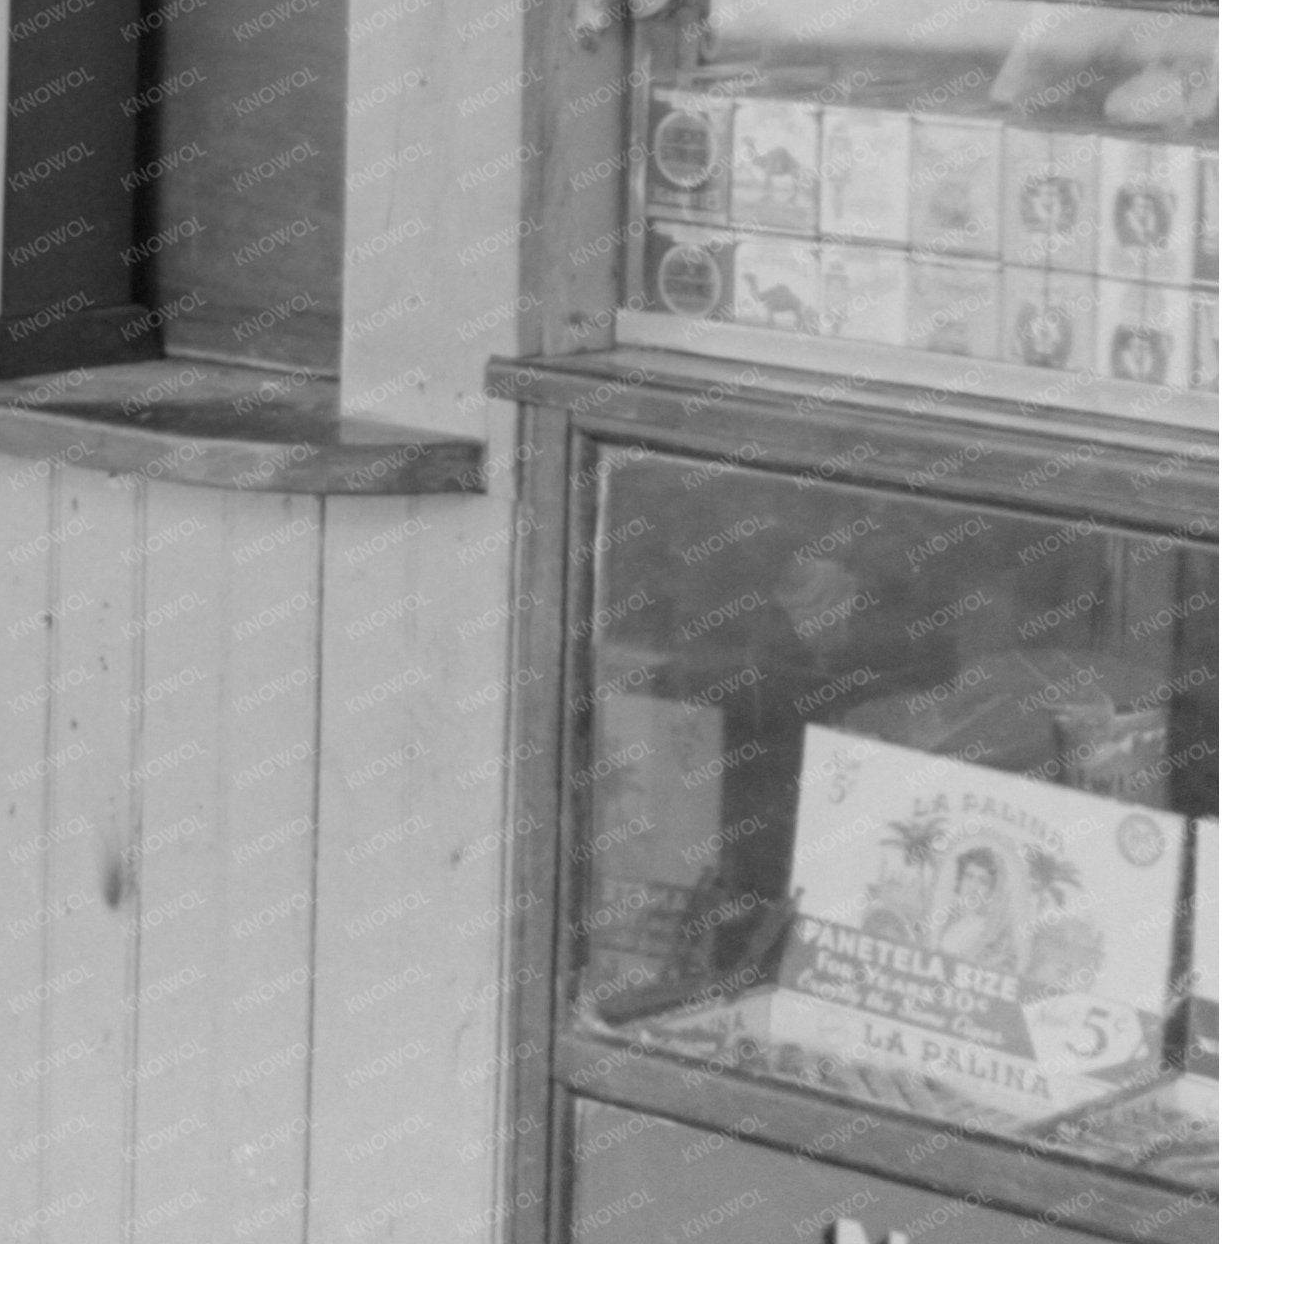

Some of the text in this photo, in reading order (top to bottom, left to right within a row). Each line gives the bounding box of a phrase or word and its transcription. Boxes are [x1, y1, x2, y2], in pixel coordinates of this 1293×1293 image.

[913, 792, 1066, 854] LA PALINA
[801, 919, 1019, 1004] PANETELA SIZE
[864, 1023, 1052, 1101] LA PALINA
